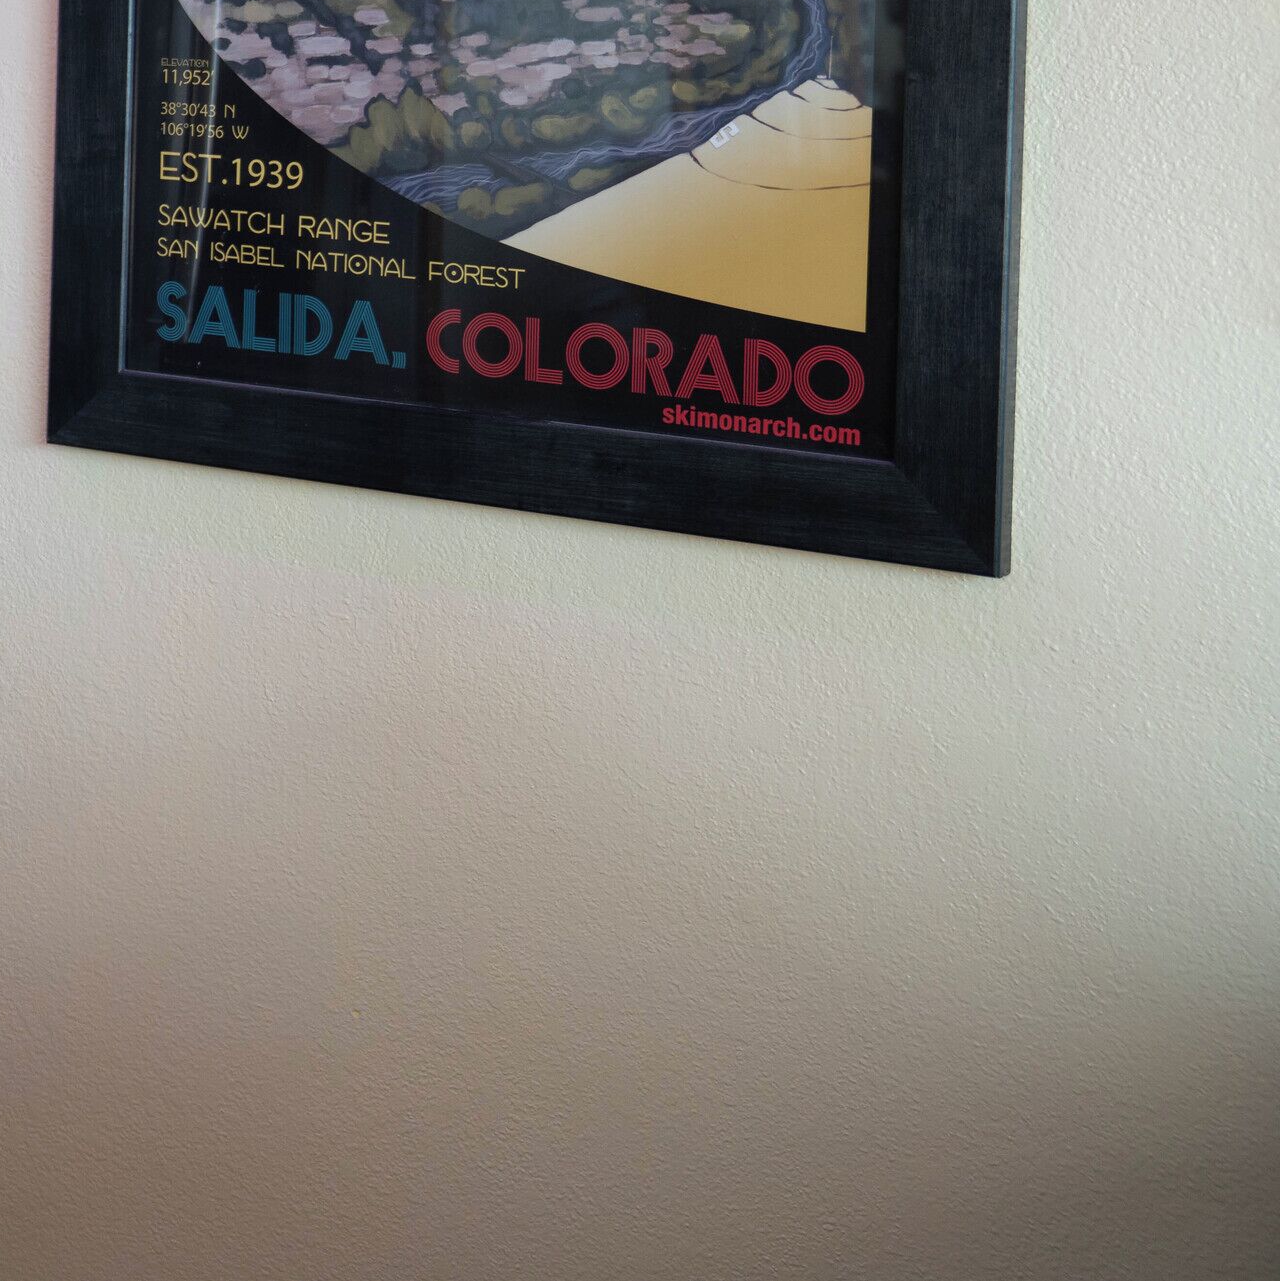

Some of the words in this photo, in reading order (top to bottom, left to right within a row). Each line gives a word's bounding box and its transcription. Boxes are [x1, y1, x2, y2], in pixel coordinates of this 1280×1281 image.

[160, 58, 209, 67] ELEVATION
[224, 104, 236, 119] N
[231, 125, 250, 140] W
[159, 151, 304, 190] EST.1939
[157, 204, 285, 236] SAWATCH
[297, 215, 391, 244] RANGE
[156, 237, 199, 259] SAN
[210, 242, 285, 268] ISABEL
[295, 250, 417, 280] NATIONAL
[428, 261, 526, 289] FOREST
[156, 280, 407, 370] SALIDA,
[426, 308, 866, 416] COLORADO
[662, 404, 862, 447] skimonarch.com
